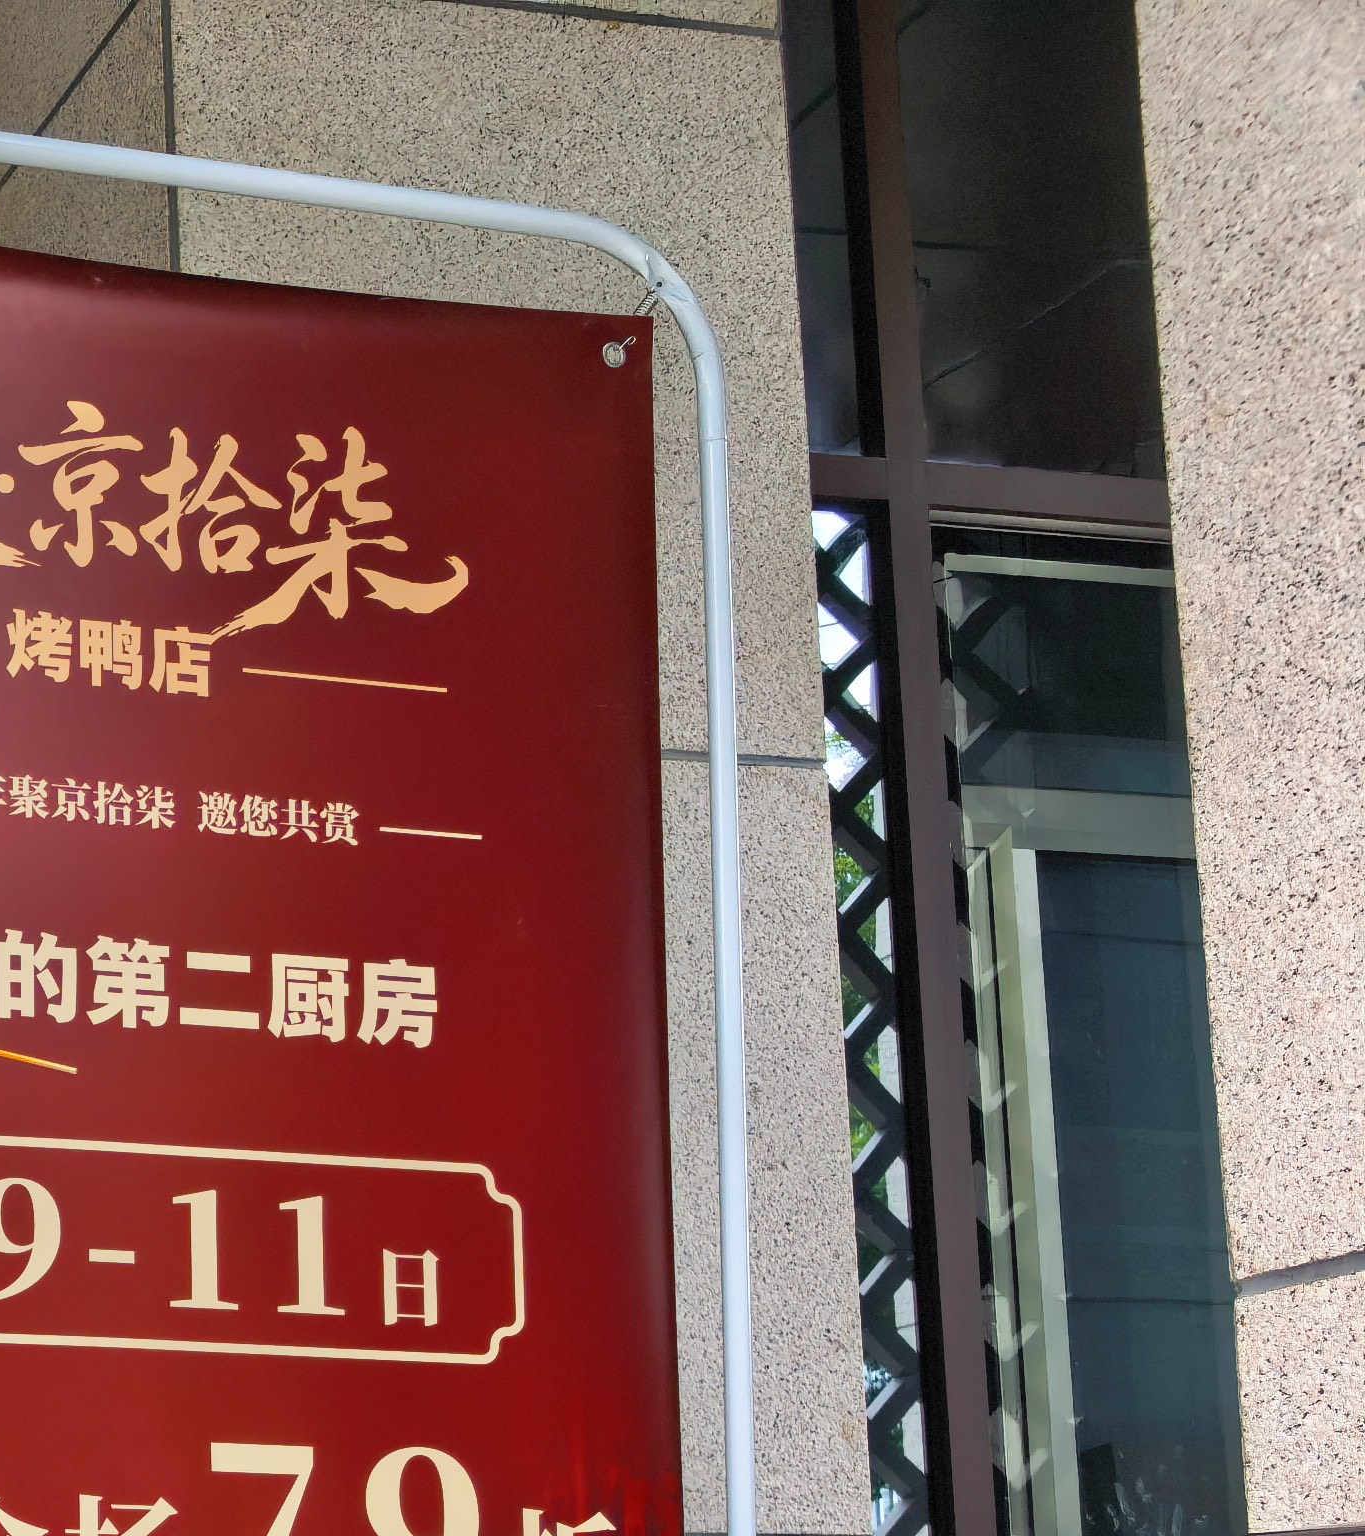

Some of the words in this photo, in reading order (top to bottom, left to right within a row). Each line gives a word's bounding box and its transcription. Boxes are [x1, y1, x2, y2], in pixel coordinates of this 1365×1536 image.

[6, 609, 212, 697] 烤鸭店
[197, 790, 360, 845] 邀您共赏
